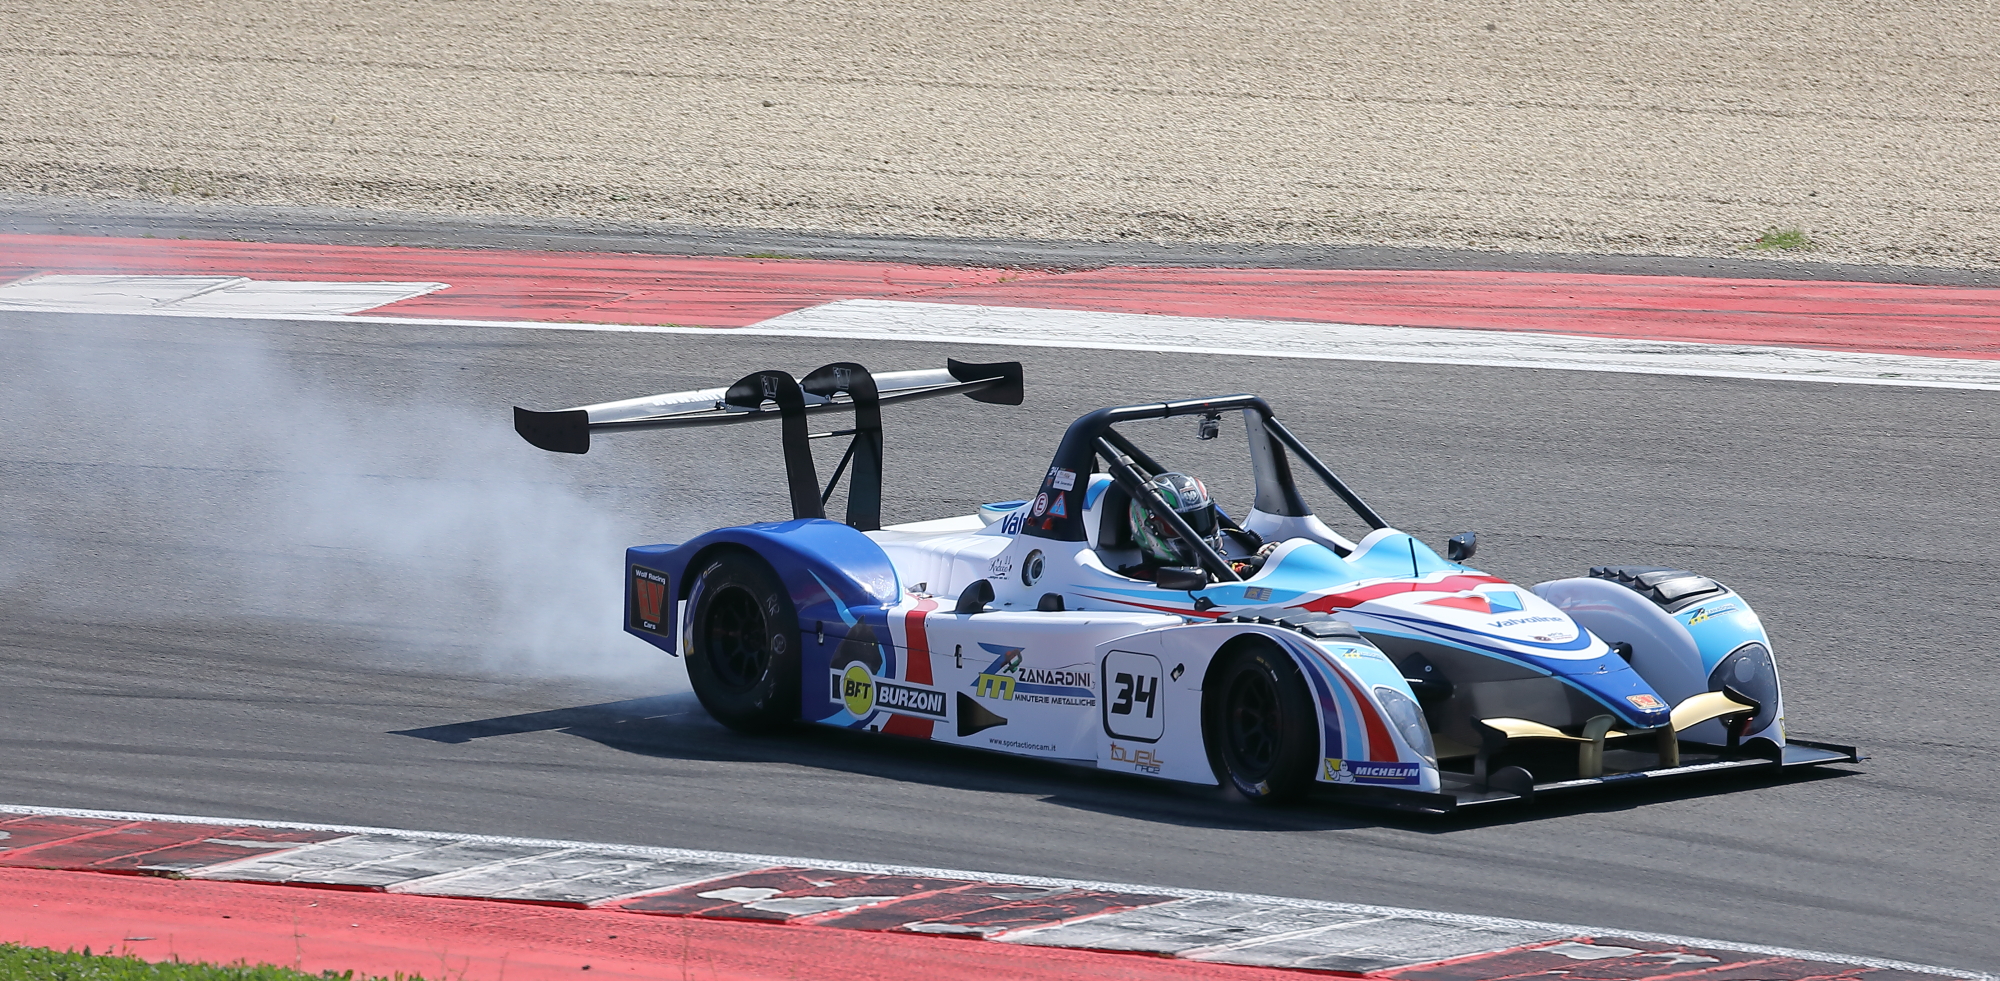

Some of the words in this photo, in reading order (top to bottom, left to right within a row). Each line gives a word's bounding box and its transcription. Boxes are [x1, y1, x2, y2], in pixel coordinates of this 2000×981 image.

[635, 569, 648, 579] Wolf
[648, 572, 666, 585] Racing
[643, 620, 657, 630] Cars
[1486, 616, 1565, 629] Valvoline
[1018, 668, 1091, 687] ZANARDINI
[844, 680, 872, 700] BFT
[878, 686, 944, 713] BURZONI
[1014, 693, 1050, 704] MINUTERIE
[1051, 697, 1096, 707] METALLICHE
[1111, 672, 1158, 719] 34
[988, 738, 1057, 752] www.sportactioncam.it
[1355, 766, 1419, 777] MICHELIN
